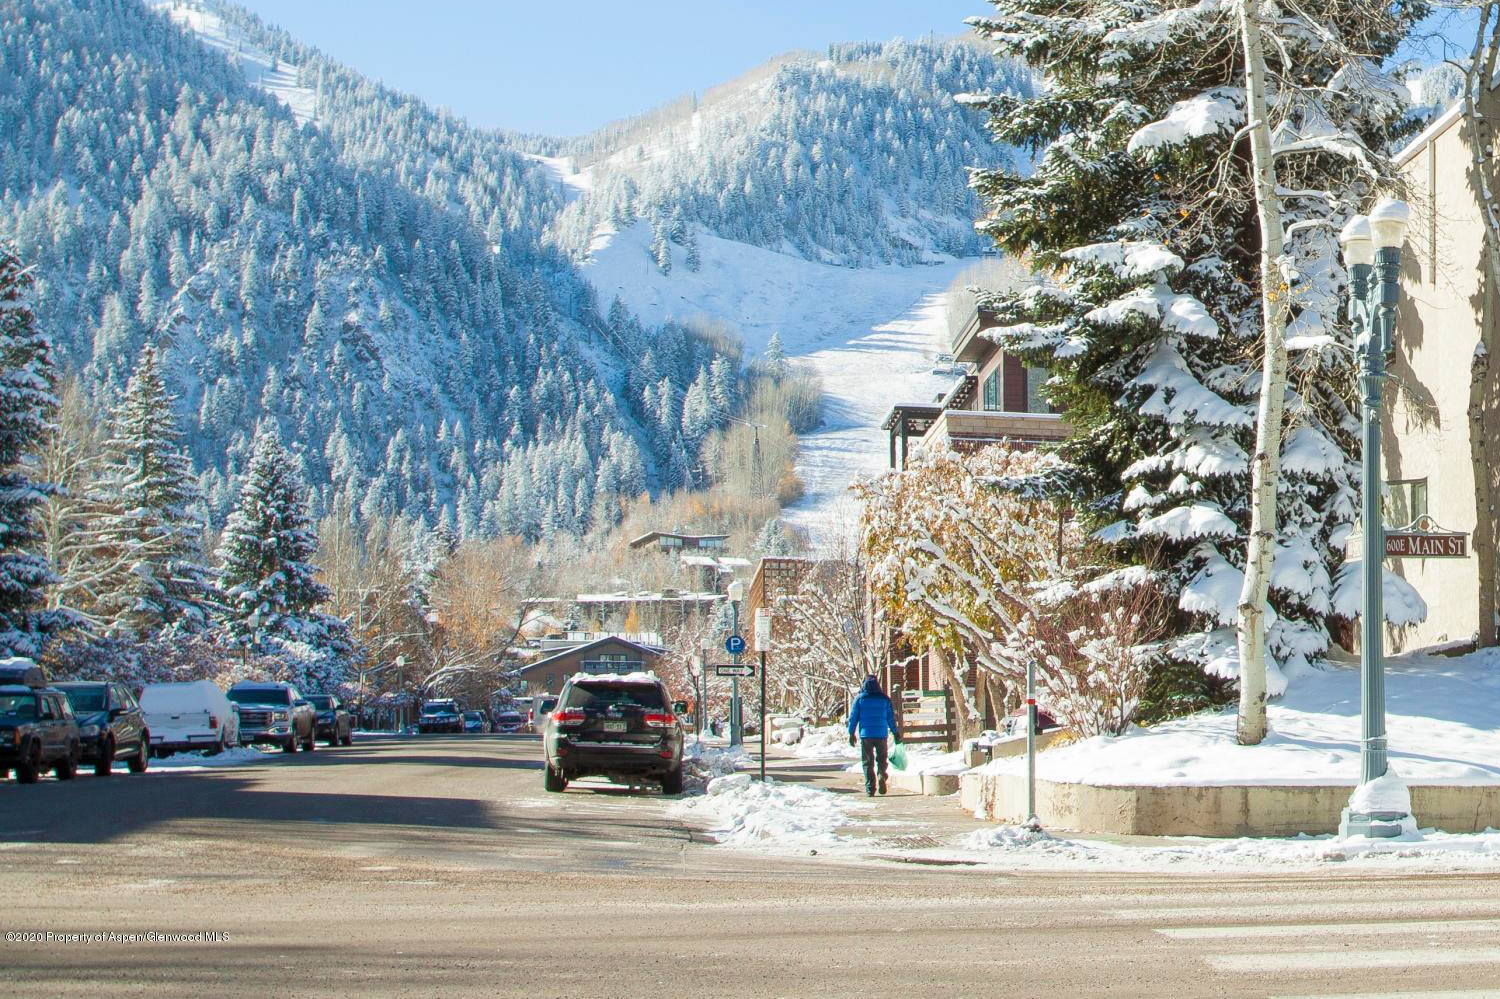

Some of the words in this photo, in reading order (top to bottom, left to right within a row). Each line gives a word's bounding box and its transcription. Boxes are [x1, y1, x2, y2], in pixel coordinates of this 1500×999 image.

[1408, 537, 1444, 554] MAIN
[1448, 537, 1463, 554] ST
[730, 638, 741, 651] P
